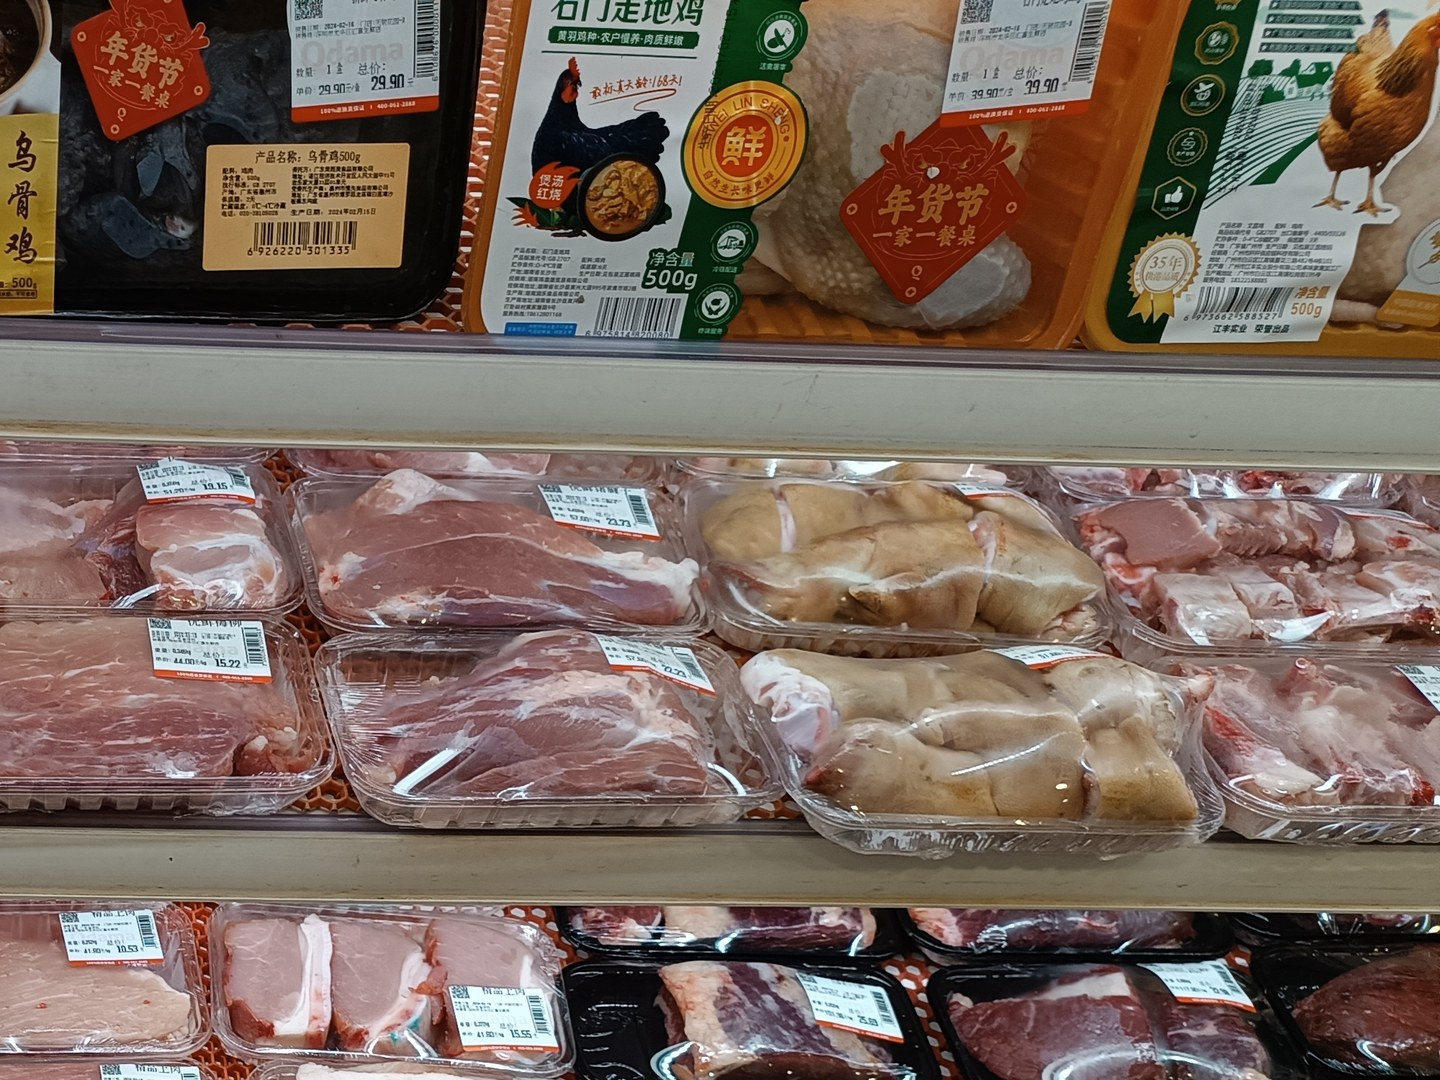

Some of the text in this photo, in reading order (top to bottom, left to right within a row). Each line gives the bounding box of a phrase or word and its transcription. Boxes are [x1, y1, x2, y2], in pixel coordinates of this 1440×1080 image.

[551, 0, 704, 27] 石门走地鸡
[100, 31, 184, 88] 年货节
[358, 63, 386, 76] 总价：
[1013, 66, 1043, 80] 总价：
[93, 64, 171, 109] 一家一餐桌
[371, 74, 405, 92] 29.90
[1024, 78, 1059, 95] 39.90
[732, 97, 791, 136] LIN SHENG
[721, 126, 767, 167] 鲜
[255, 150, 361, 164] 产品名称：乌骨鸡500g
[538, 174, 564, 187] 煲汤
[4, 129, 38, 265] 乌骨鸡
[536, 187, 562, 201] 红烧
[878, 183, 990, 225] 年货节
[873, 224, 976, 248] 一家一餐桌
[258, 246, 302, 257] 926220
[307, 246, 350, 256] 301335
[649, 251, 695, 268] 净含量
[1150, 254, 1184, 271] 35年
[645, 269, 698, 289] 500g
[1294, 286, 1331, 299] 净含量
[1195, 313, 1233, 322] 973662
[1290, 302, 1323, 318] 500g
[1212, 324, 1290, 334] 江丰实业 荣誉出品
[203, 482, 228, 490] 19.15
[216, 659, 241, 669] 15.22
[118, 945, 139, 954] 10.53
[510, 1030, 533, 1039] 15.55
